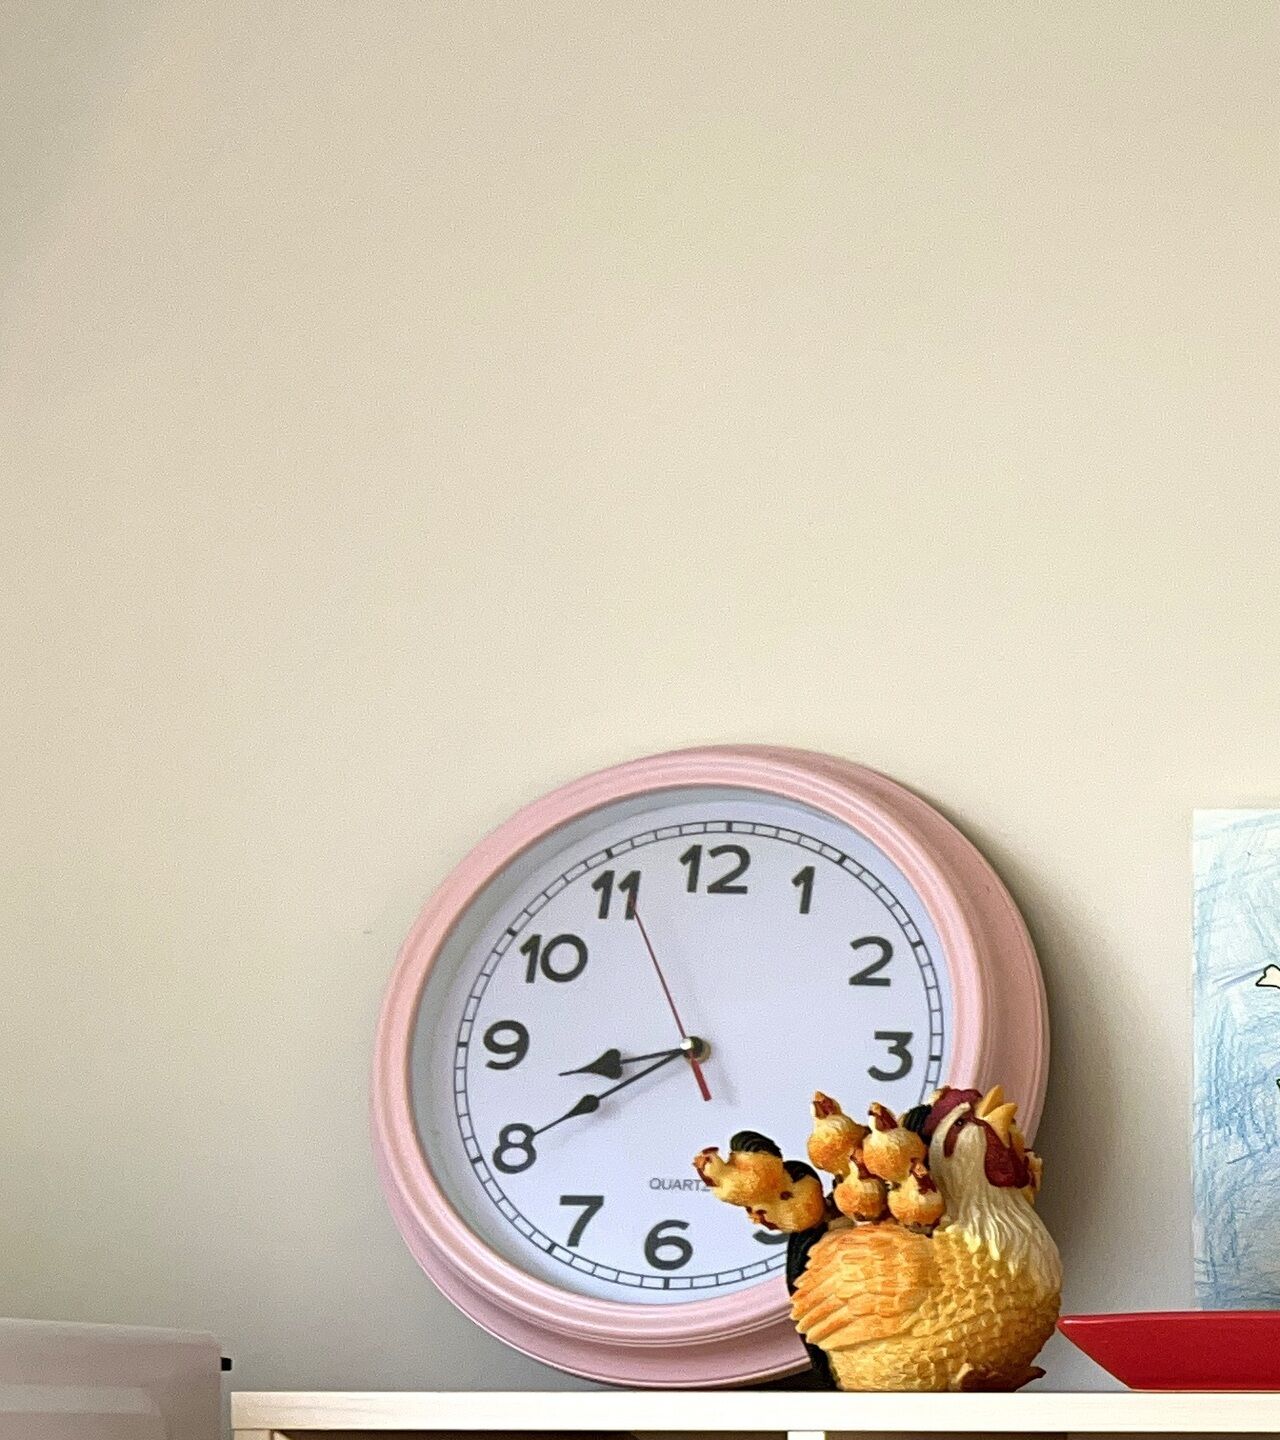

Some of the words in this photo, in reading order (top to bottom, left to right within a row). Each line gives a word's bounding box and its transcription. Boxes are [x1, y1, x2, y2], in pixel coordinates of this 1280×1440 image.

[592, 870, 642, 920] 11
[679, 844, 751, 895] 12
[791, 866, 816, 914] 1
[520, 934, 589, 983] 10
[847, 936, 894, 988] 2
[482, 1019, 530, 1071] 9
[866, 1030, 913, 1082] 3
[493, 1123, 538, 1174] 8
[650, 1177, 711, 1192] QUART
[559, 1194, 605, 1247] 7
[643, 1219, 694, 1270] 6
